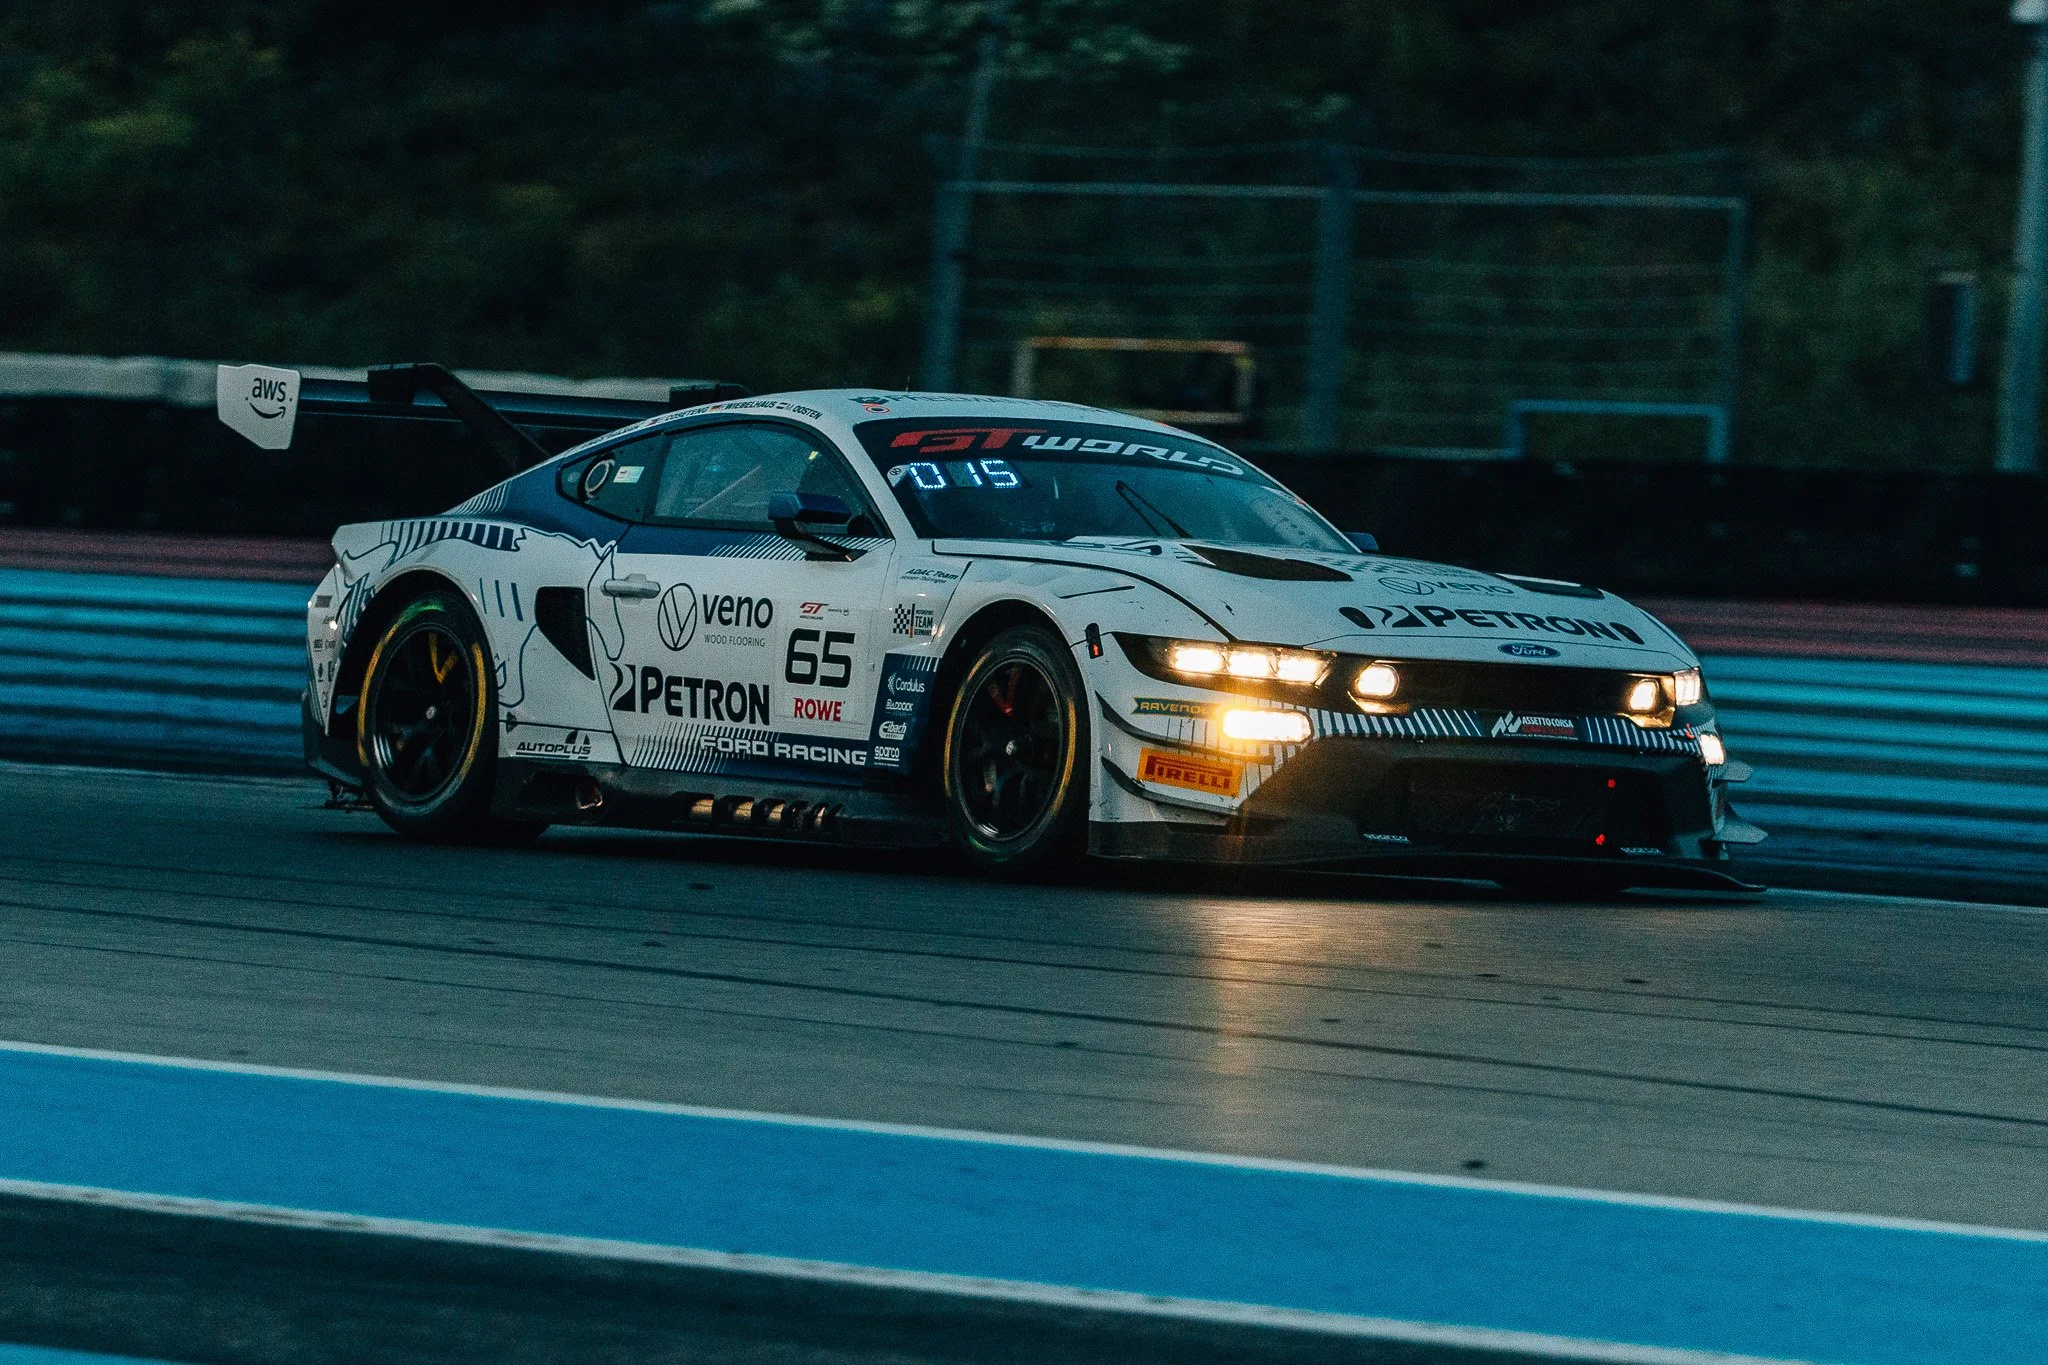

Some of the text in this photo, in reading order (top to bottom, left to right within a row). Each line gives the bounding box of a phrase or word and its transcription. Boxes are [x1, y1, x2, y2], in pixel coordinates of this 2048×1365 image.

[252, 377, 287, 403] aws
[891, 427, 1244, 475] GT WORLD
[702, 593, 774, 629] veno
[915, 615, 934, 628] TEAM
[1417, 605, 1621, 642] PETRON
[703, 634, 766, 648] WOOD FLOORING
[1511, 644, 1550, 656] Ford
[785, 628, 856, 688] 65
[641, 665, 770, 726] PETRON
[793, 697, 843, 723] ROWE
[1522, 716, 1574, 729] ASSETTO CORSA
[516, 741, 592, 755] AUTOPLUS
[700, 735, 868, 766] FORD RACING
[874, 745, 900, 760] sparco
[1144, 754, 1233, 790] PIRELLI
